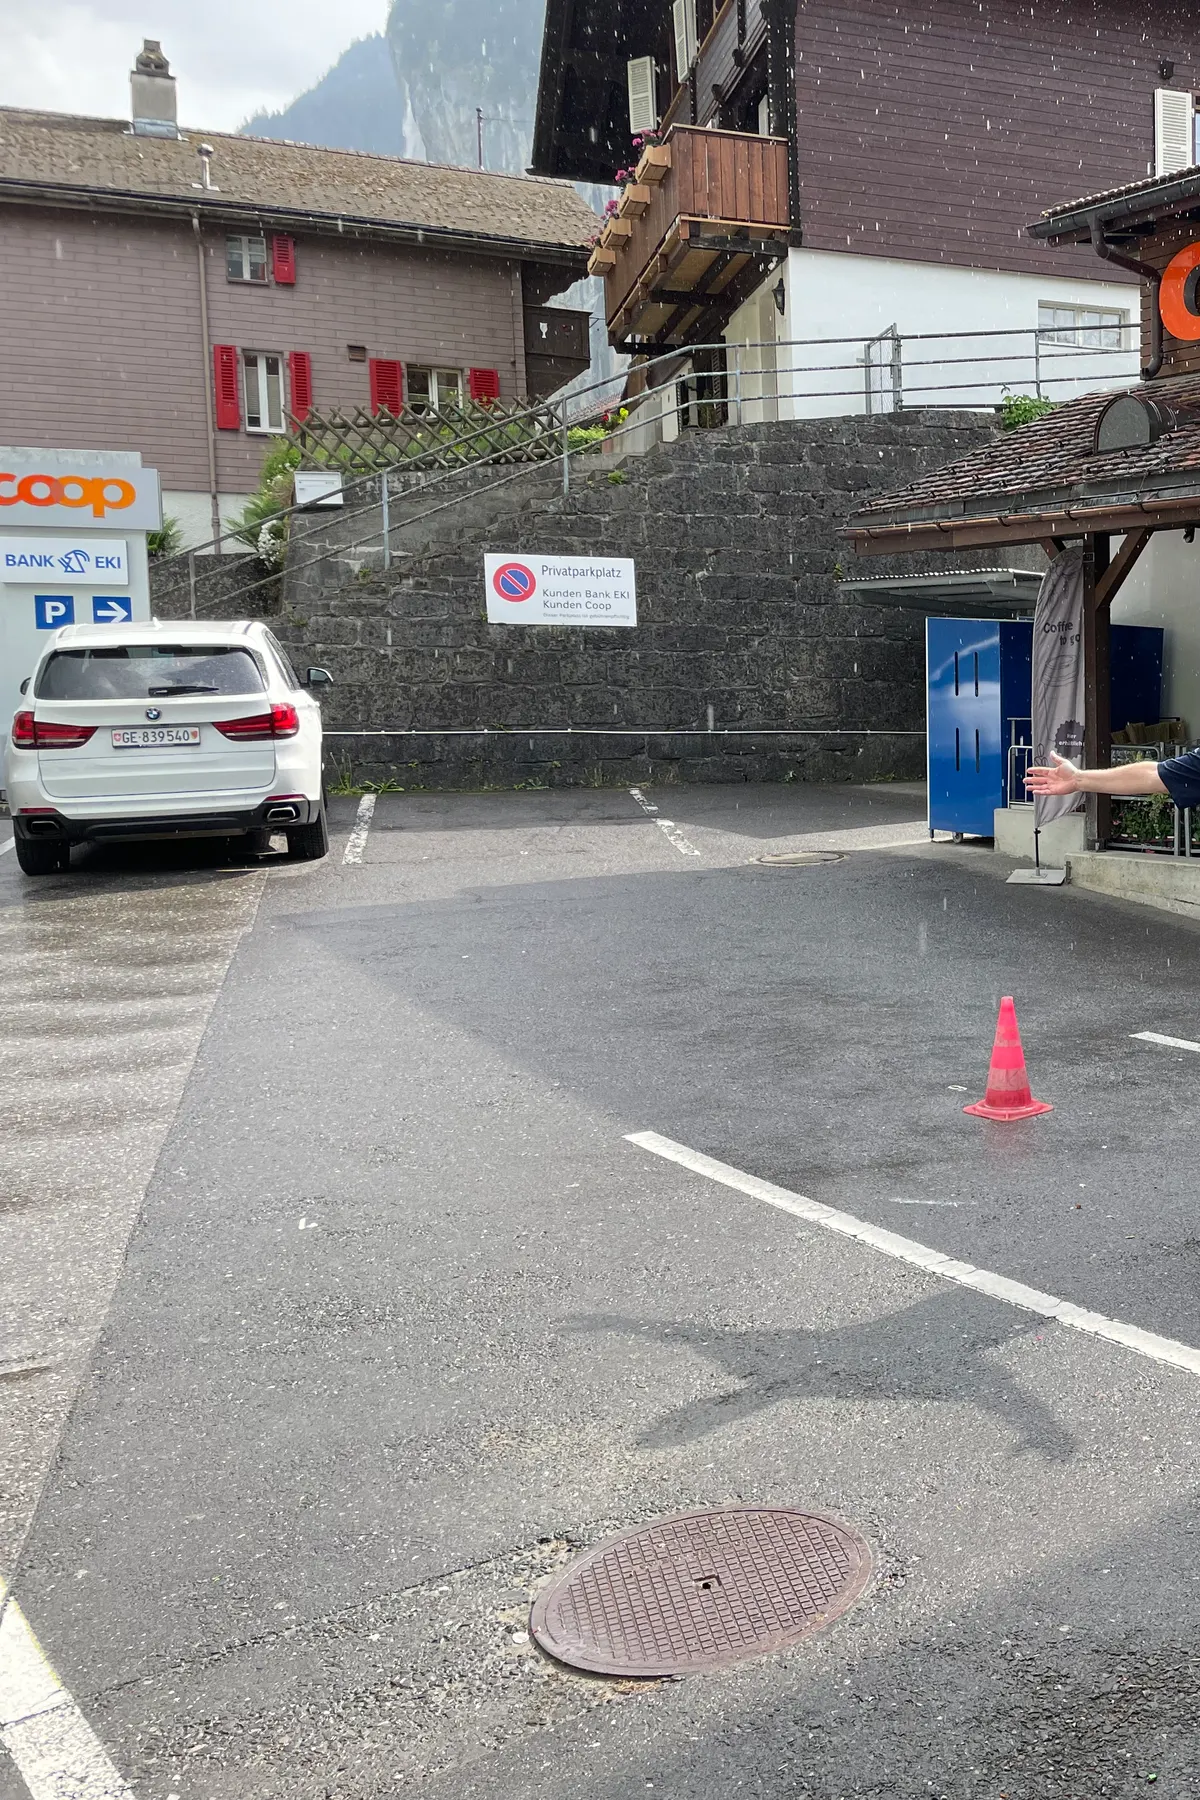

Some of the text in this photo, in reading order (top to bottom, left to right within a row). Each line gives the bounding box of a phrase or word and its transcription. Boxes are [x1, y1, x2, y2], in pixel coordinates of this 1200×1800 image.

[5, 554, 121, 569] BANK EKI
[541, 564, 622, 579] Privatparkplatz
[542, 588, 630, 599] Kunden Bank EKI
[45, 601, 66, 624] P
[543, 600, 612, 611] Kunden Coop
